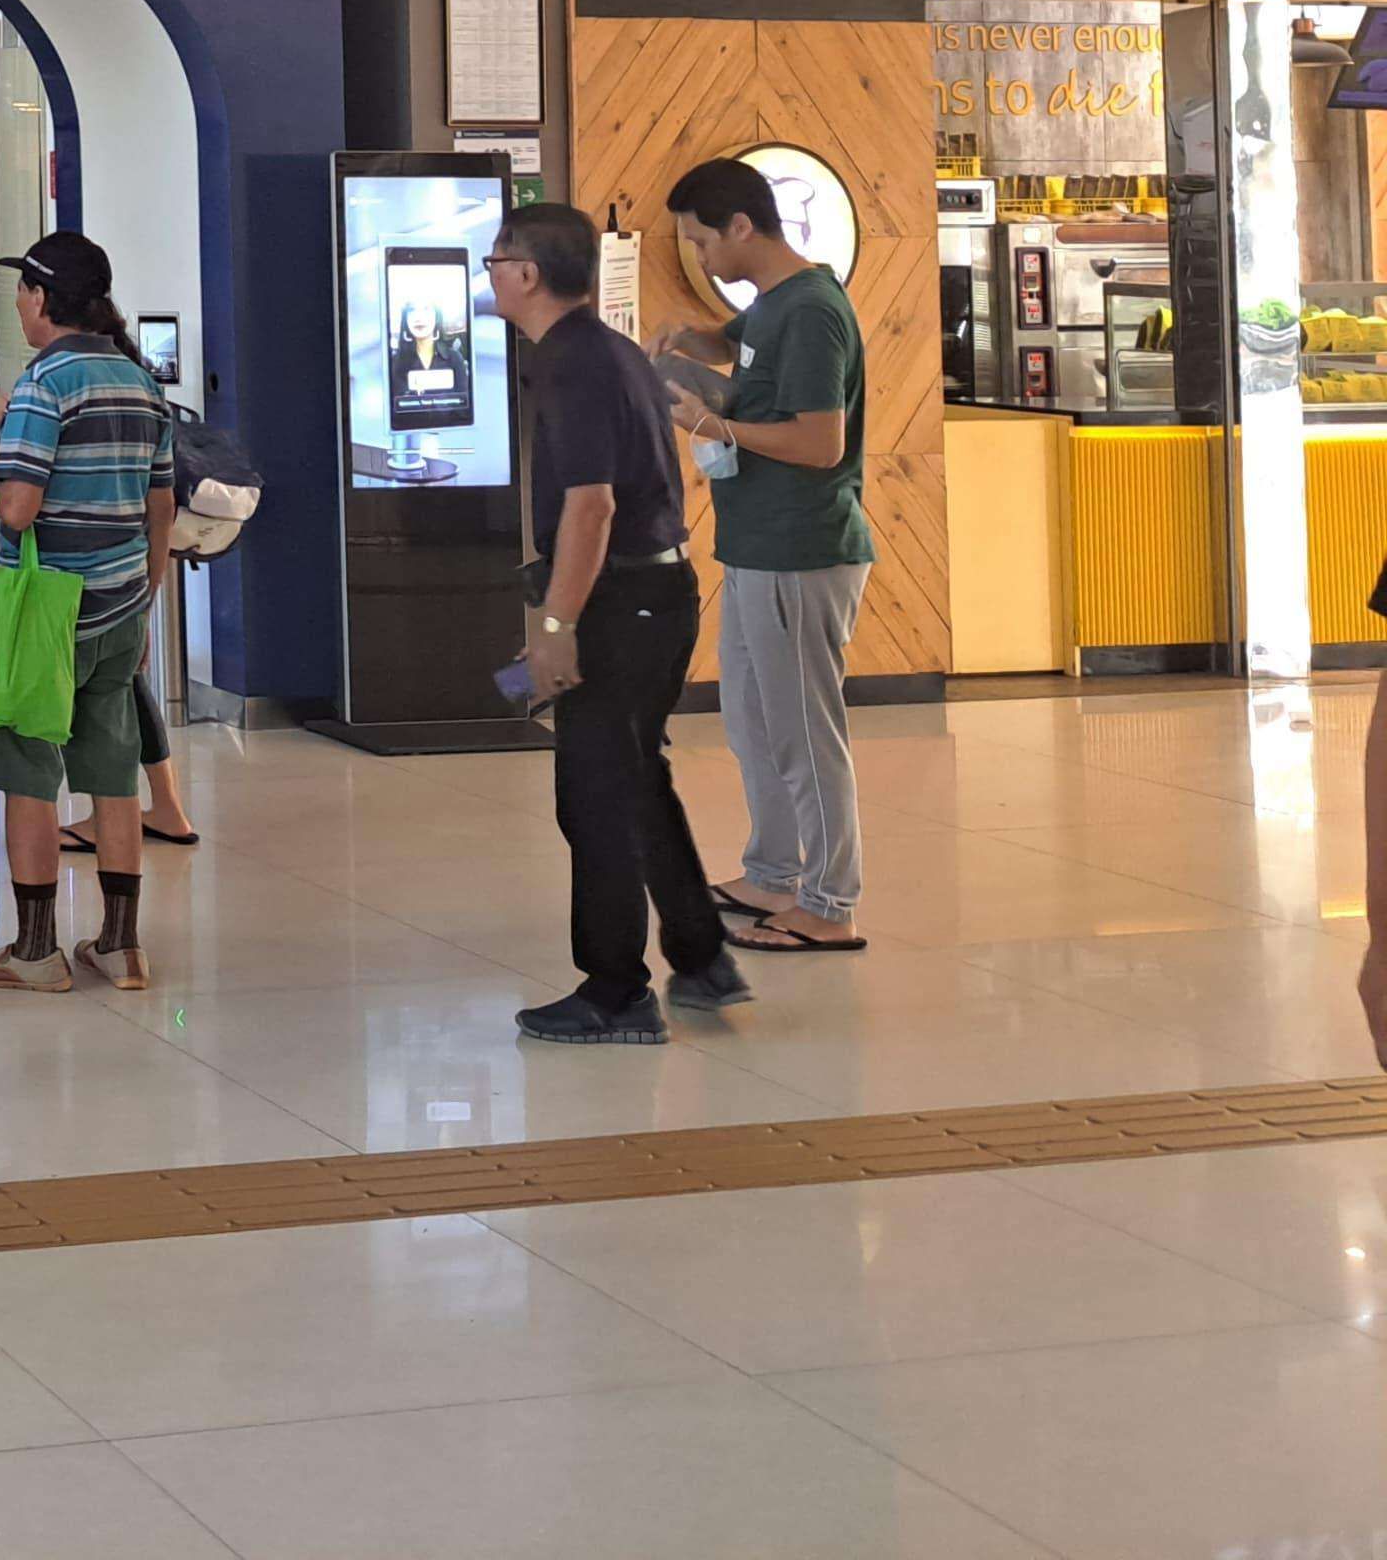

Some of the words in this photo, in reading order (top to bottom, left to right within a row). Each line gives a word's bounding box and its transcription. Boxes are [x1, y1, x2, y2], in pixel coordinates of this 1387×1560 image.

[968, 24, 1063, 52] never
[985, 71, 1036, 117] to
[1046, 67, 1140, 117] die
